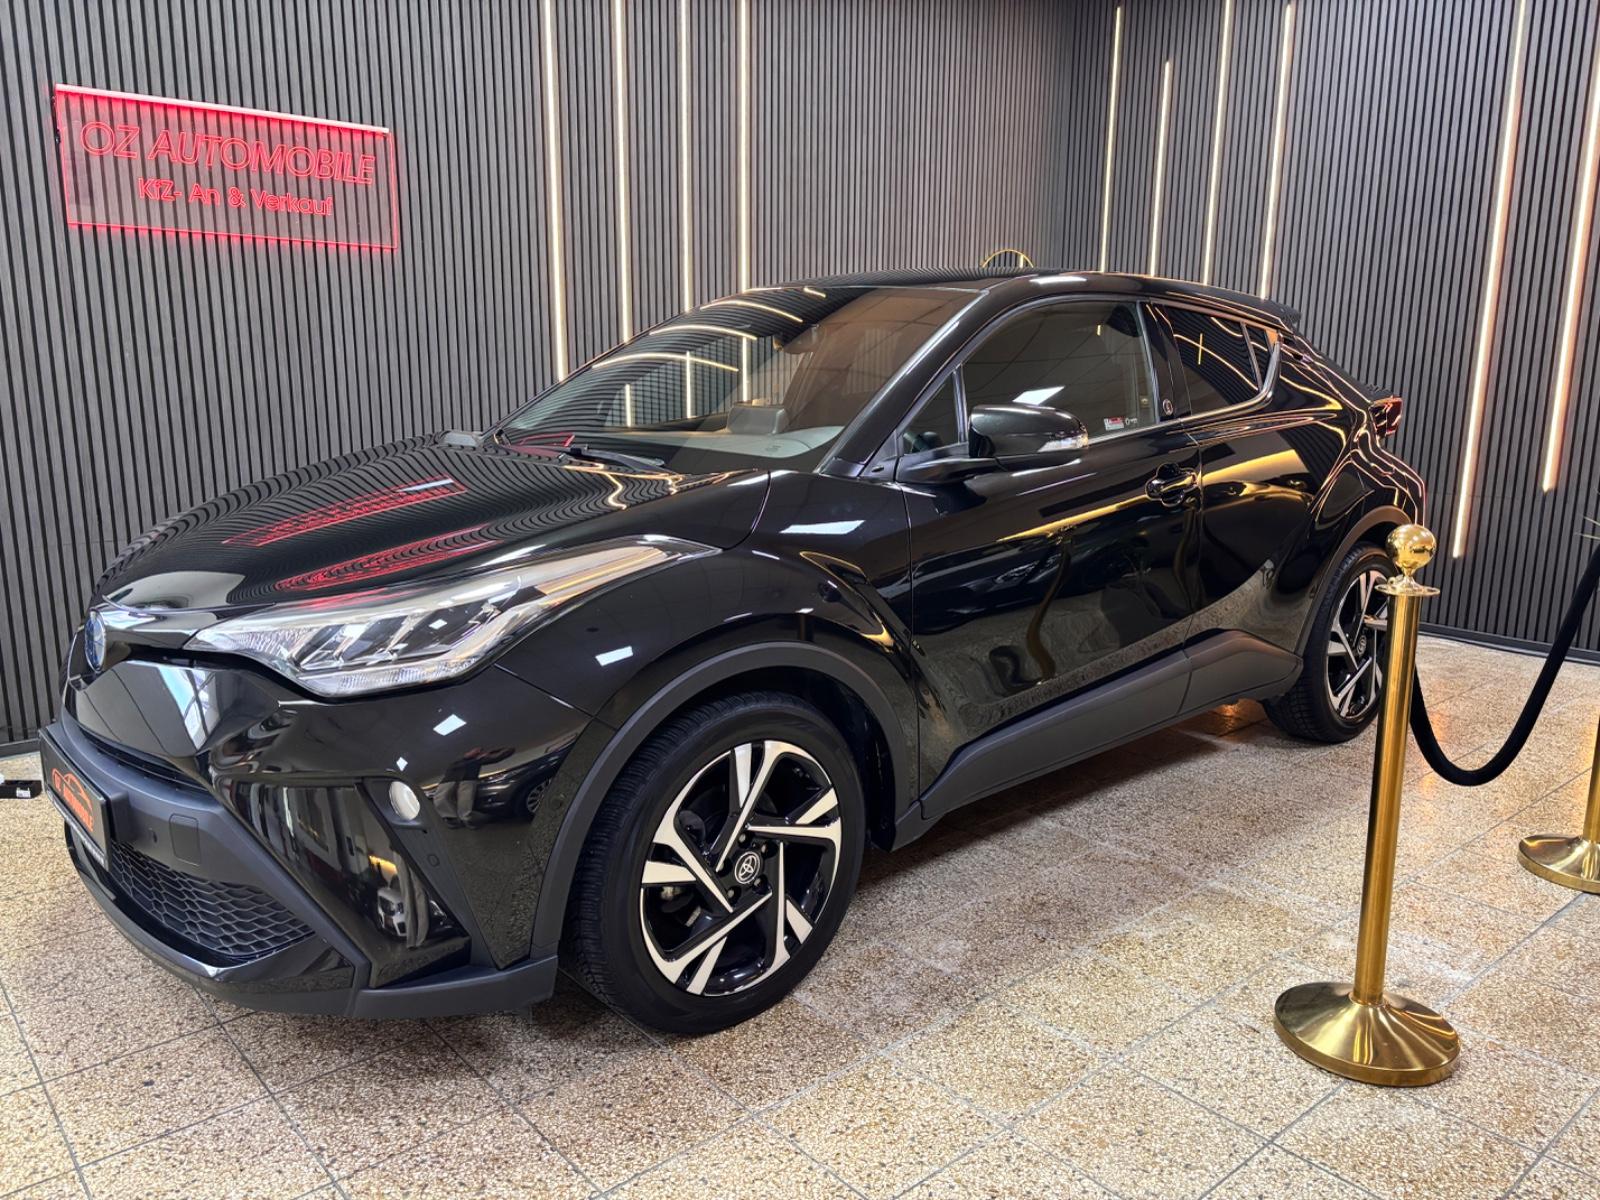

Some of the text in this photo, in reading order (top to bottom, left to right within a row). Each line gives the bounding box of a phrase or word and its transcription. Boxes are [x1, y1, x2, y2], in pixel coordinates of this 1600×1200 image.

[81, 121, 375, 185] OZ AUTOMOBILE
[188, 183, 220, 206] An
[228, 186, 247, 208] &
[250, 188, 333, 216] Verkauf
